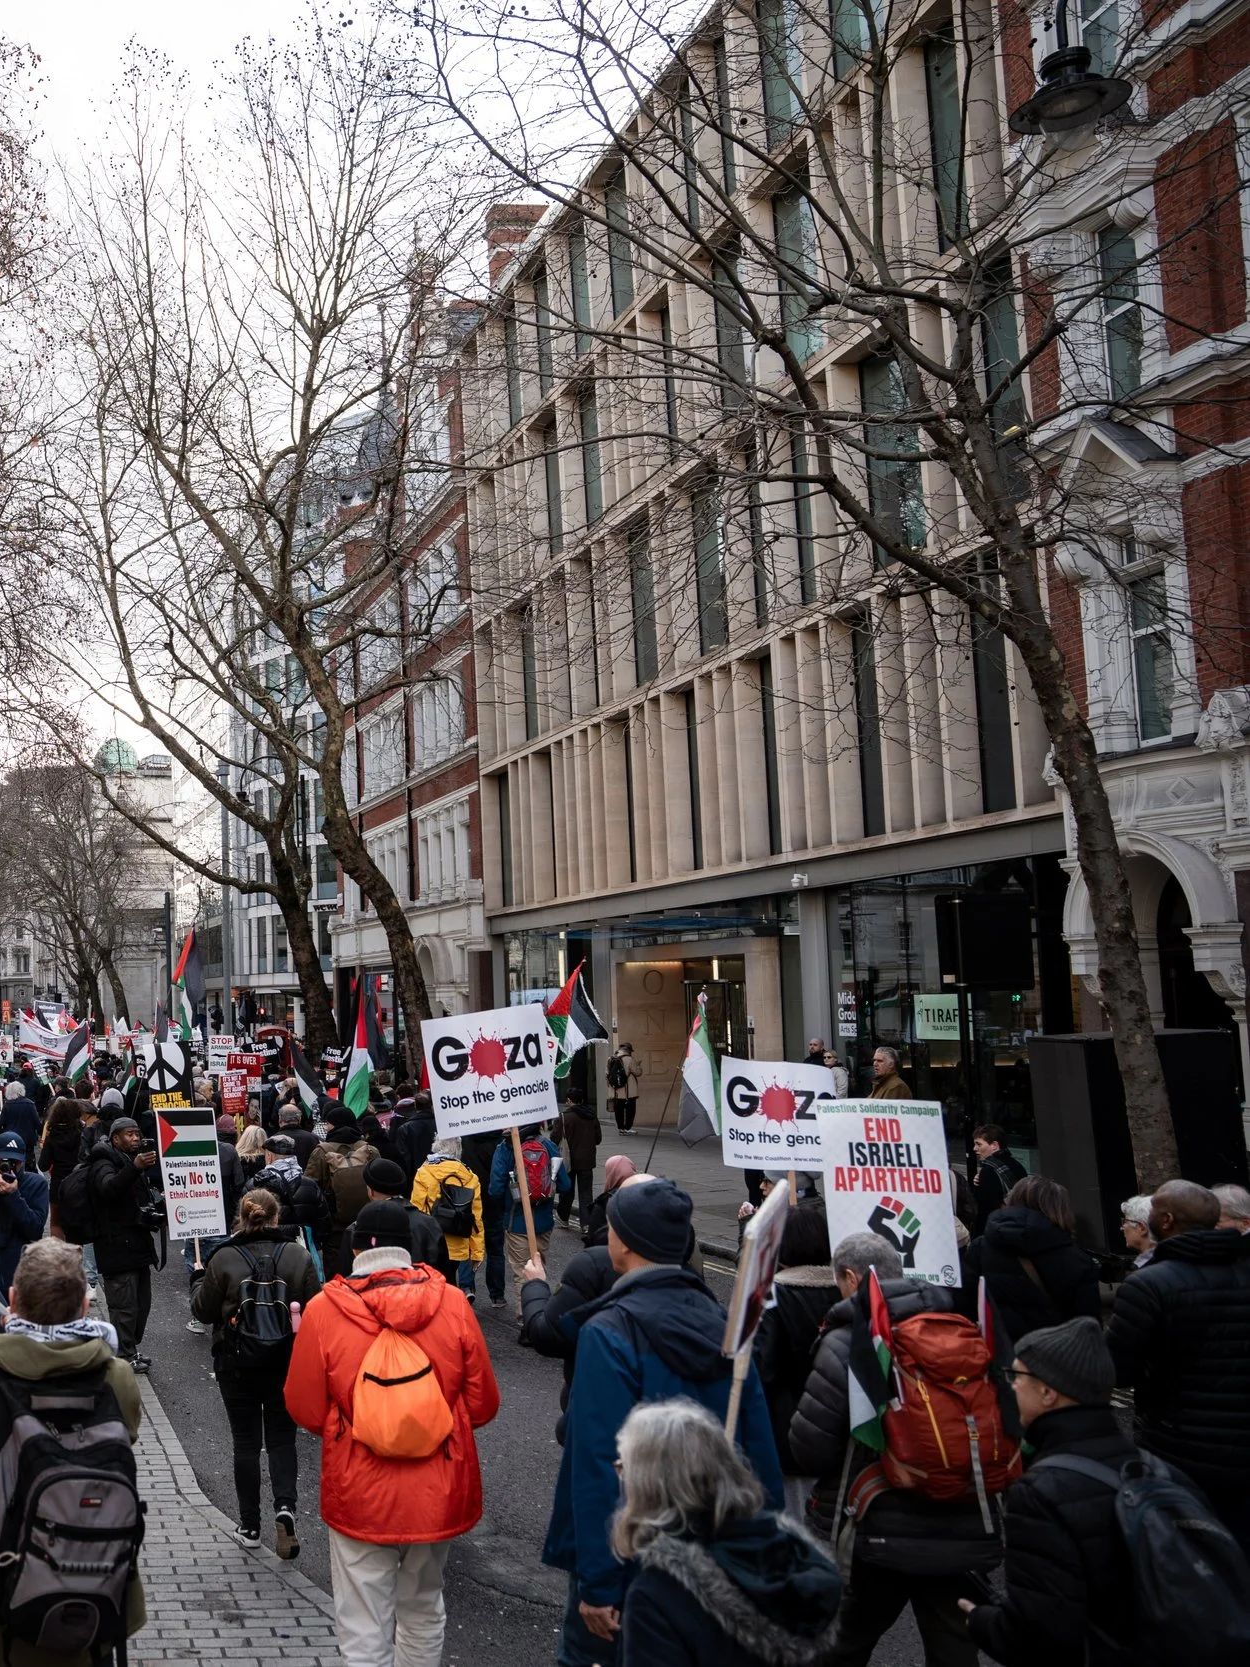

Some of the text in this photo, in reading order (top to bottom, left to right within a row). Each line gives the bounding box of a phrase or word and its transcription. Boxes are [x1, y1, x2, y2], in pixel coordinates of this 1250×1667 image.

[251, 1043, 267, 1051] Free
[326, 1046, 341, 1055] Free
[230, 1056, 257, 1065] IT IS OVER
[322, 1053, 343, 1063] Palestin
[432, 1033, 543, 1081] Gza
[152, 1092, 182, 1103] END THE
[440, 1080, 549, 1109] Stop the genocide
[817, 1104, 940, 1117] Palestine Solidarity Campaign
[482, 1113, 508, 1121] Coalition
[863, 1117, 902, 1143] END
[729, 1128, 754, 1145] Stop
[758, 1131, 780, 1144] the
[848, 1142, 923, 1168] ISRAELI
[168, 1172, 216, 1188] Say No to
[835, 1167, 942, 1194] APARTHEID
[170, 1189, 219, 1199] Ethnic Cleansing
[177, 1228, 220, 1237] www.PFBUK.com
